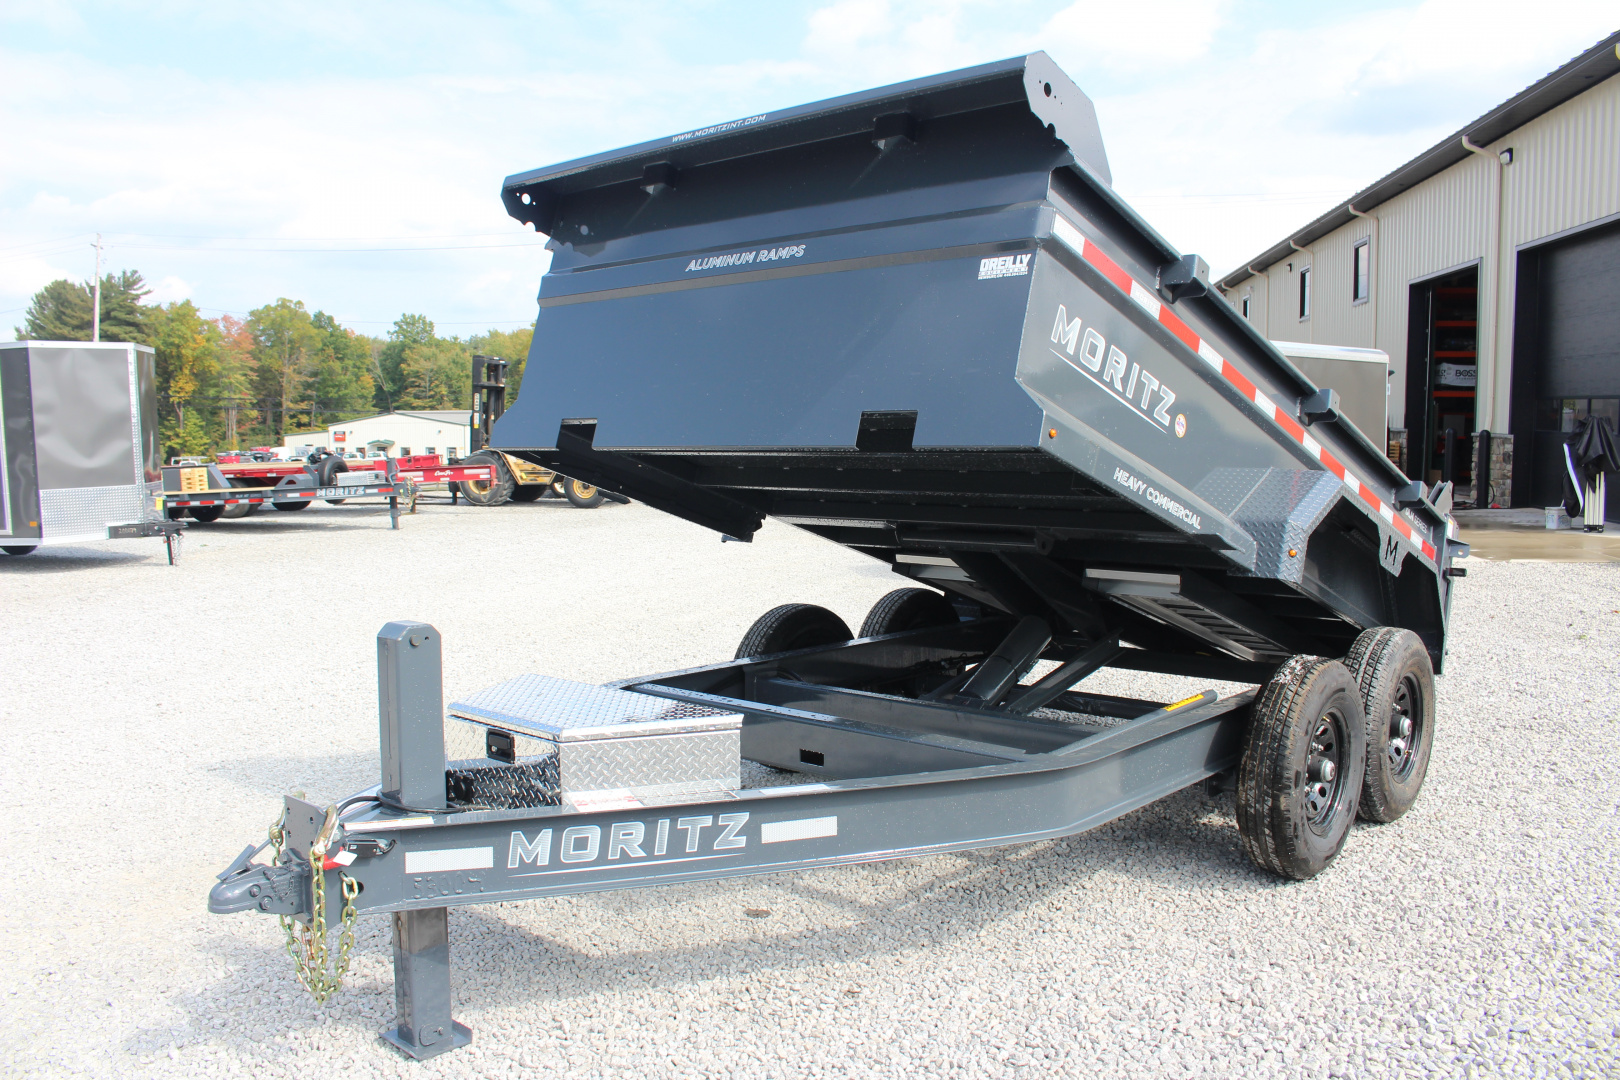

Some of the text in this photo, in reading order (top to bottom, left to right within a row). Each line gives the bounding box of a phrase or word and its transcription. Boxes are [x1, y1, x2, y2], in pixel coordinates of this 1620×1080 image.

[672, 114, 766, 142] WWW.MORITZINT.COM
[685, 244, 806, 272] ALUMINUM RAMPS
[1051, 304, 1176, 427] MORITZ
[316, 486, 365, 497] MORITZ
[1113, 467, 1201, 529] HEAVY COMMERCIAL
[1385, 535, 1399, 566] M
[507, 812, 750, 868] MORITZ
